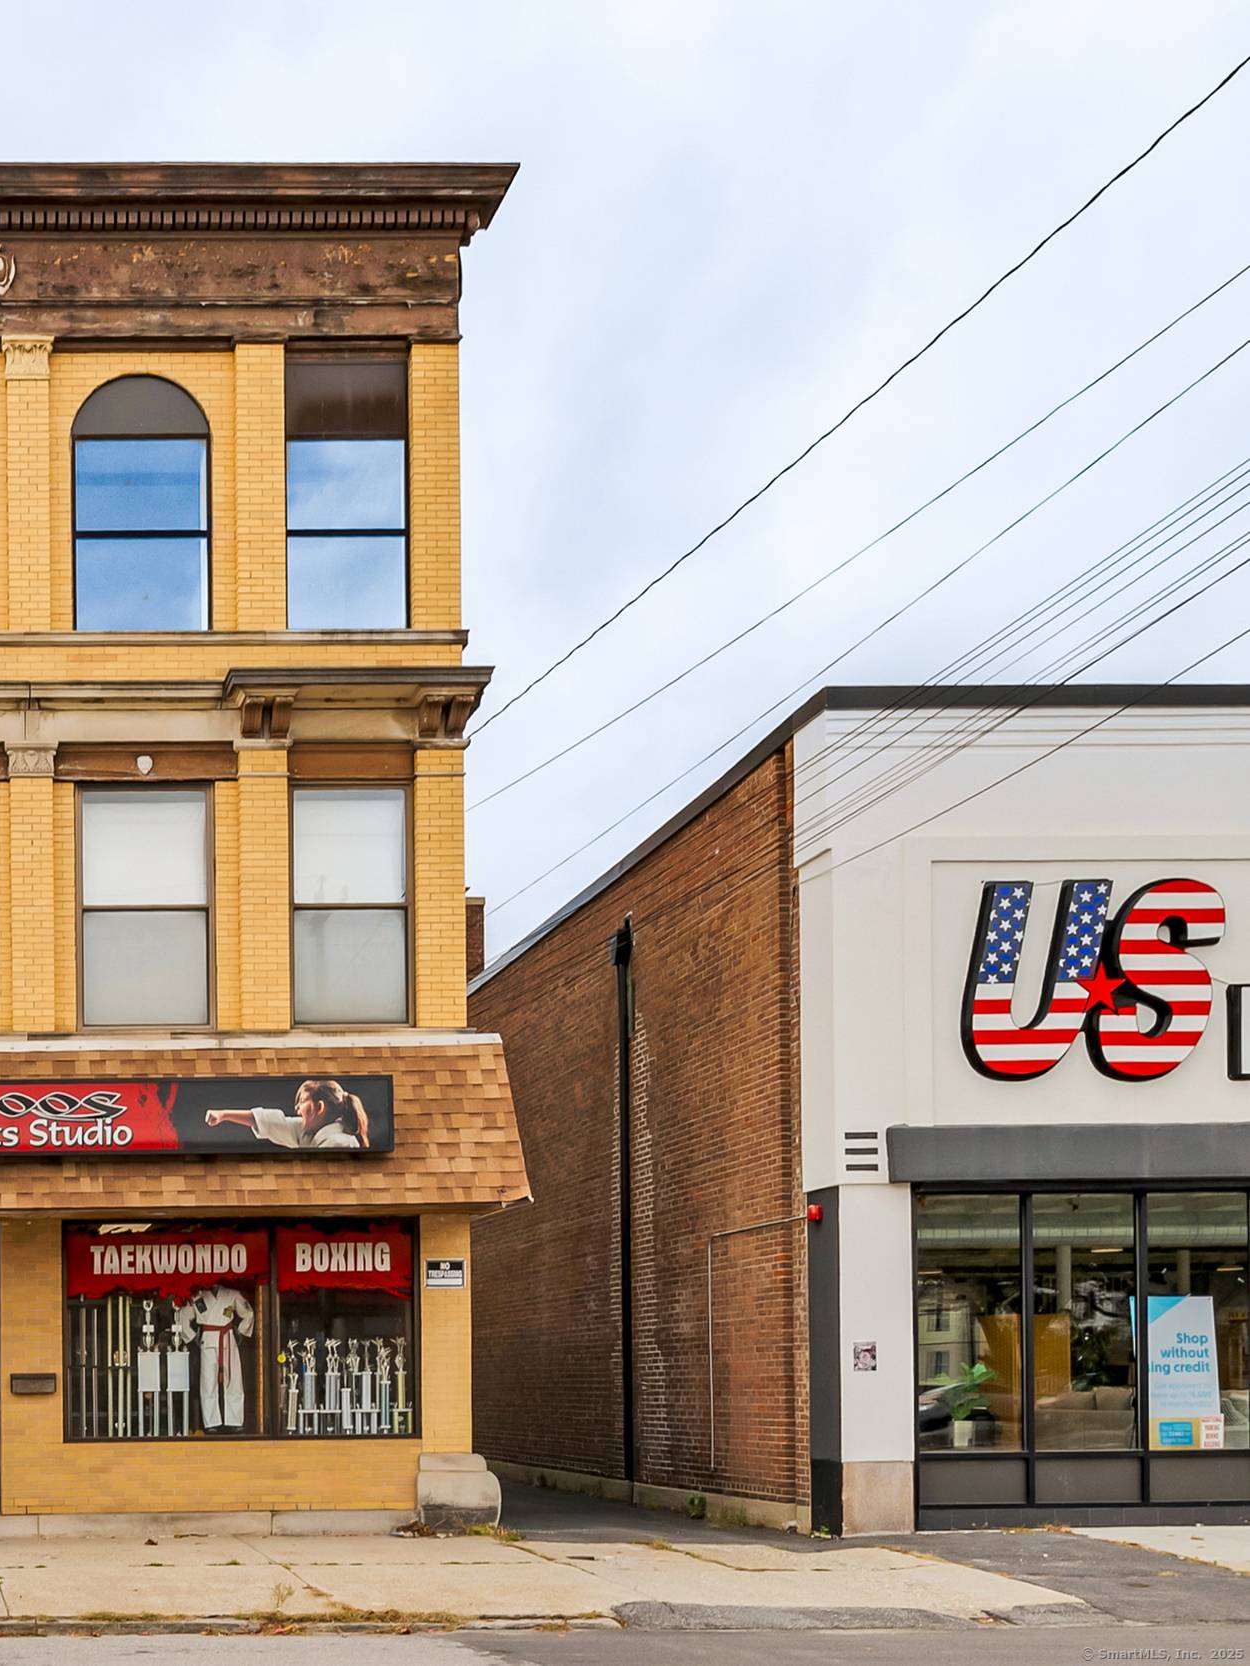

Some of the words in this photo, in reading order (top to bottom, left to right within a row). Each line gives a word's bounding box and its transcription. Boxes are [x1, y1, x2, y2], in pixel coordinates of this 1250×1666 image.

[960, 877, 1226, 1082] US
[28, 1116, 134, 1148] Studio
[89, 1243, 248, 1276] TAEKWONDO
[294, 1241, 392, 1273] BOXING
[440, 1262, 451, 1270] NO
[1176, 1332, 1209, 1346] Shop
[1160, 1346, 1210, 1359] without
[1148, 1360, 1171, 1376] ing
[1173, 1360, 1211, 1373] credit
